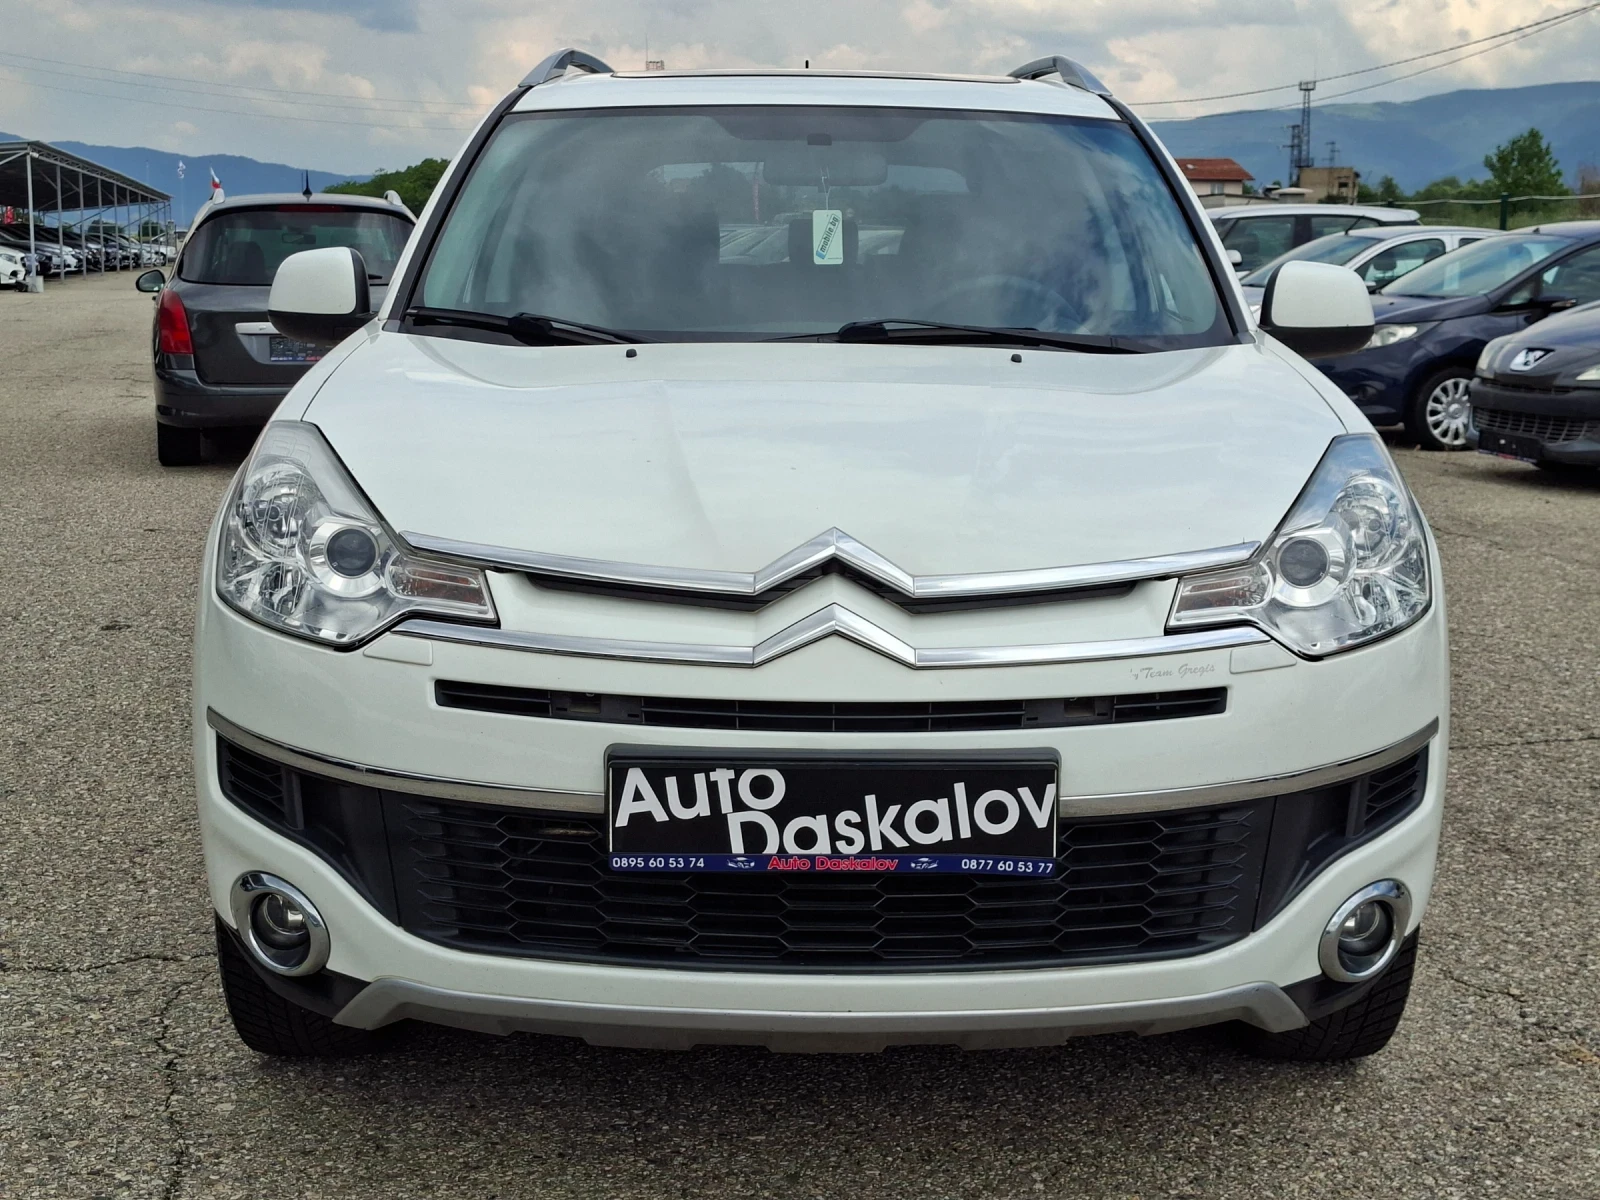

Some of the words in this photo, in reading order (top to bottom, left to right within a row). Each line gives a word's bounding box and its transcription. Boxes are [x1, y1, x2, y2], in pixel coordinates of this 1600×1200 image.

[1140, 667, 1173, 679] Team
[615, 767, 786, 828] Auto
[727, 781, 1056, 855] Daskalov
[612, 857, 645, 868] 0895
[649, 857, 665, 868] 60
[668, 857, 685, 868] 53
[689, 857, 705, 868] 74
[767, 856, 811, 870] Auto
[815, 856, 899, 871] Daskalov
[961, 859, 994, 870] 0877
[997, 861, 1014, 871] 60
[1017, 861, 1034, 872] 53
[1038, 862, 1053, 874] 77
